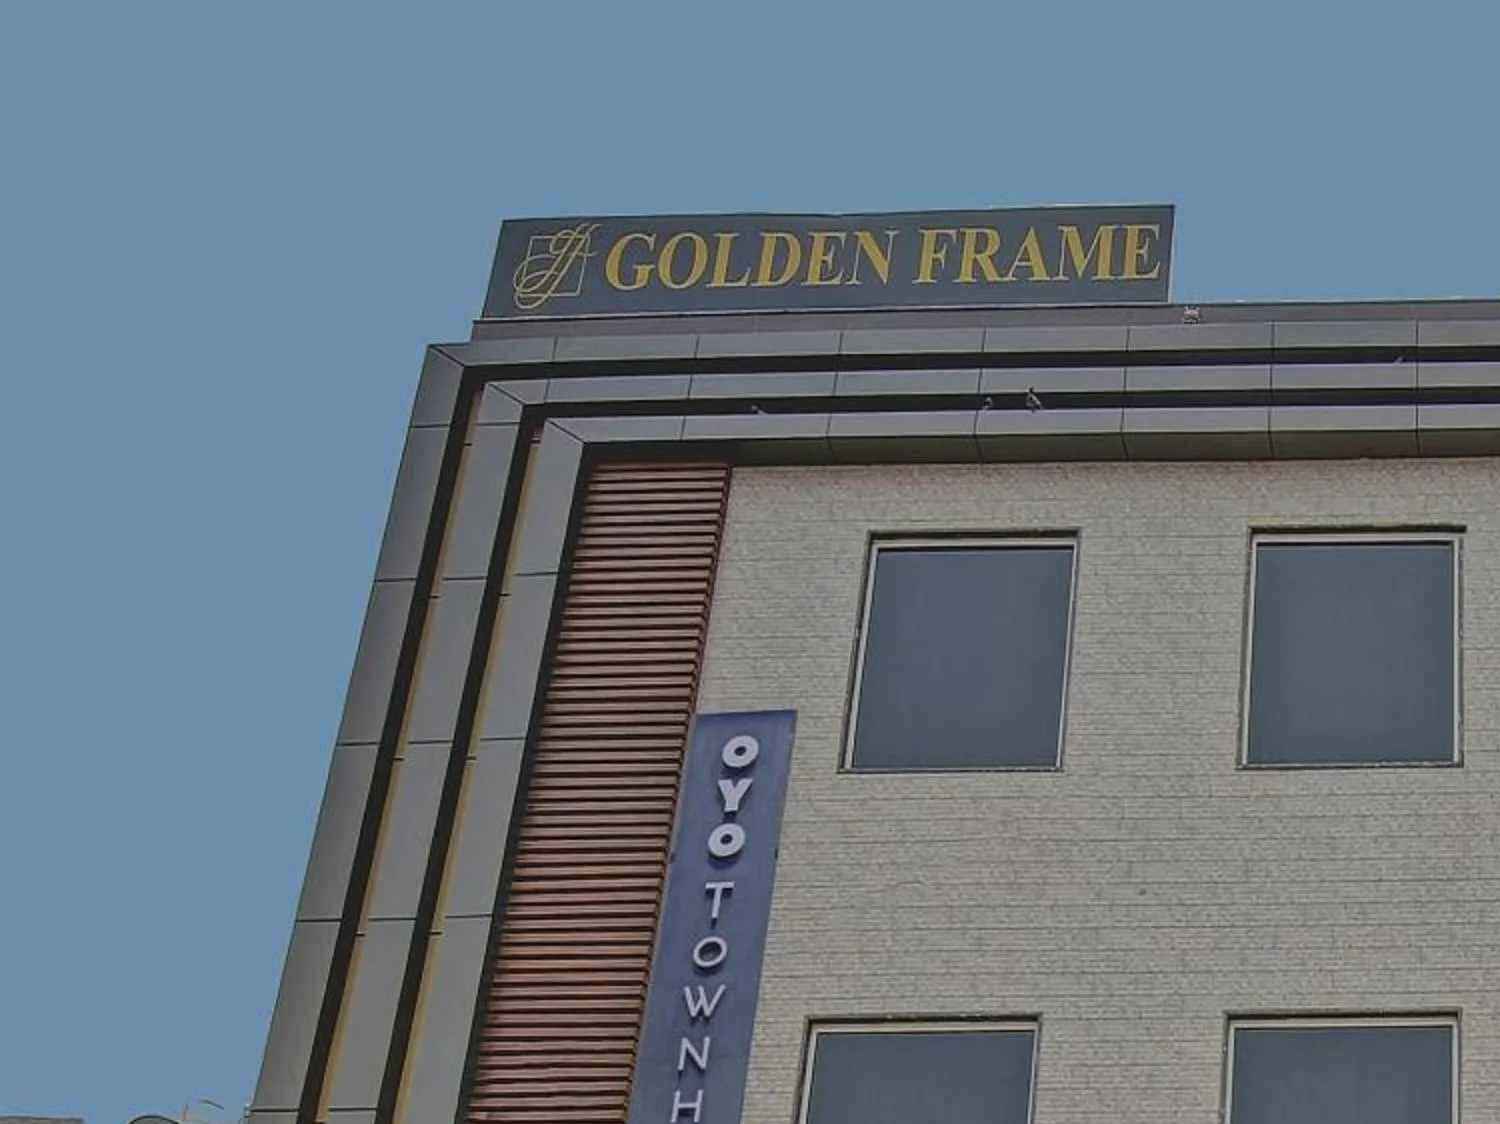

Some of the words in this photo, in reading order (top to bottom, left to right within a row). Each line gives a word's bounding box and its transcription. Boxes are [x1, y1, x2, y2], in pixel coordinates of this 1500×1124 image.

[604, 228, 900, 292] GOLDEN
[911, 222, 1161, 285] FRAME
[706, 734, 760, 858] OYO
